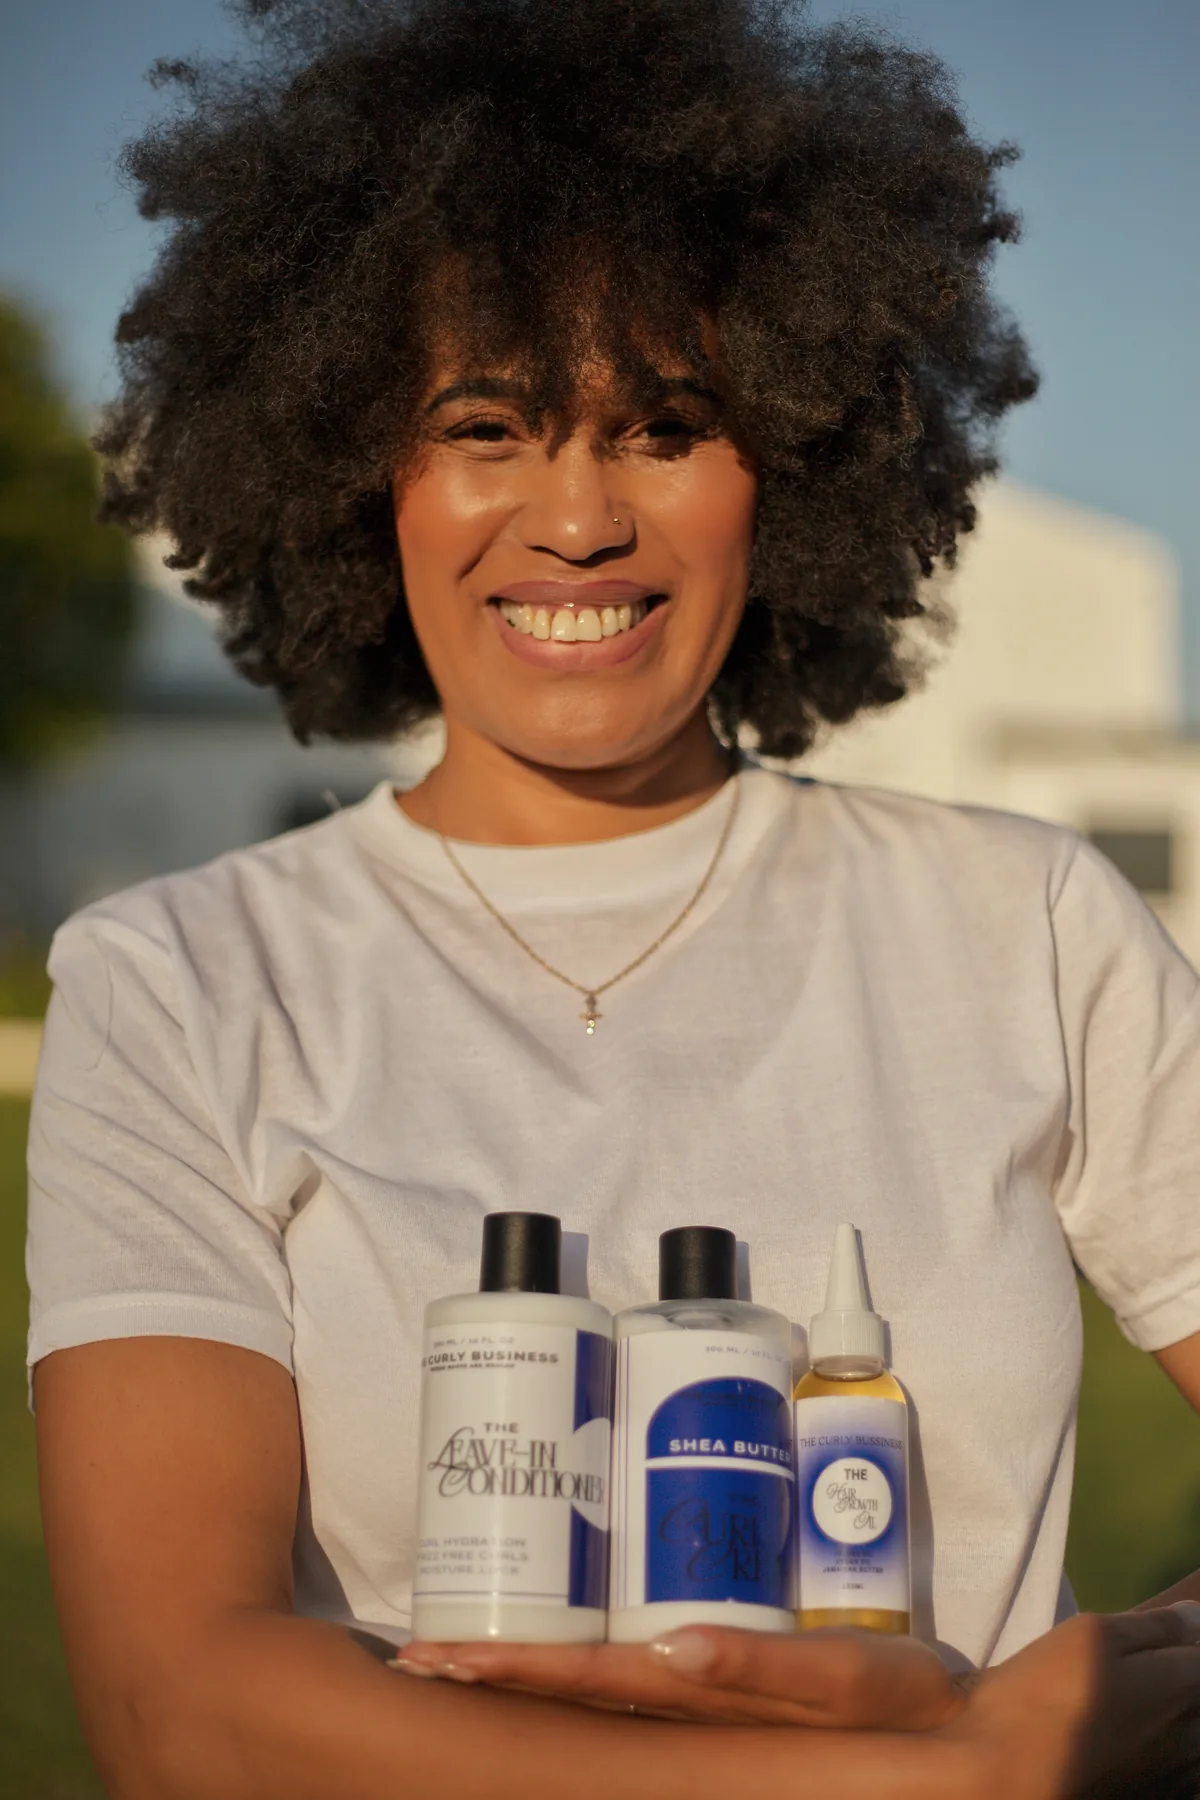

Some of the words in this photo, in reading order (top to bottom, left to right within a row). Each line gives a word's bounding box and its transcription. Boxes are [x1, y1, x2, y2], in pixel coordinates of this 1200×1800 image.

[428, 1351, 466, 1365] CURLY
[471, 1351, 559, 1364] BUSINESS
[483, 1422, 519, 1434] THE
[427, 1426, 557, 1471] LEAVE-IN
[669, 1438, 726, 1452] SHEA
[844, 1468, 868, 1480] THE
[439, 1462, 605, 1504] CONDITIONER
[443, 1537, 526, 1548] HYDRAON
